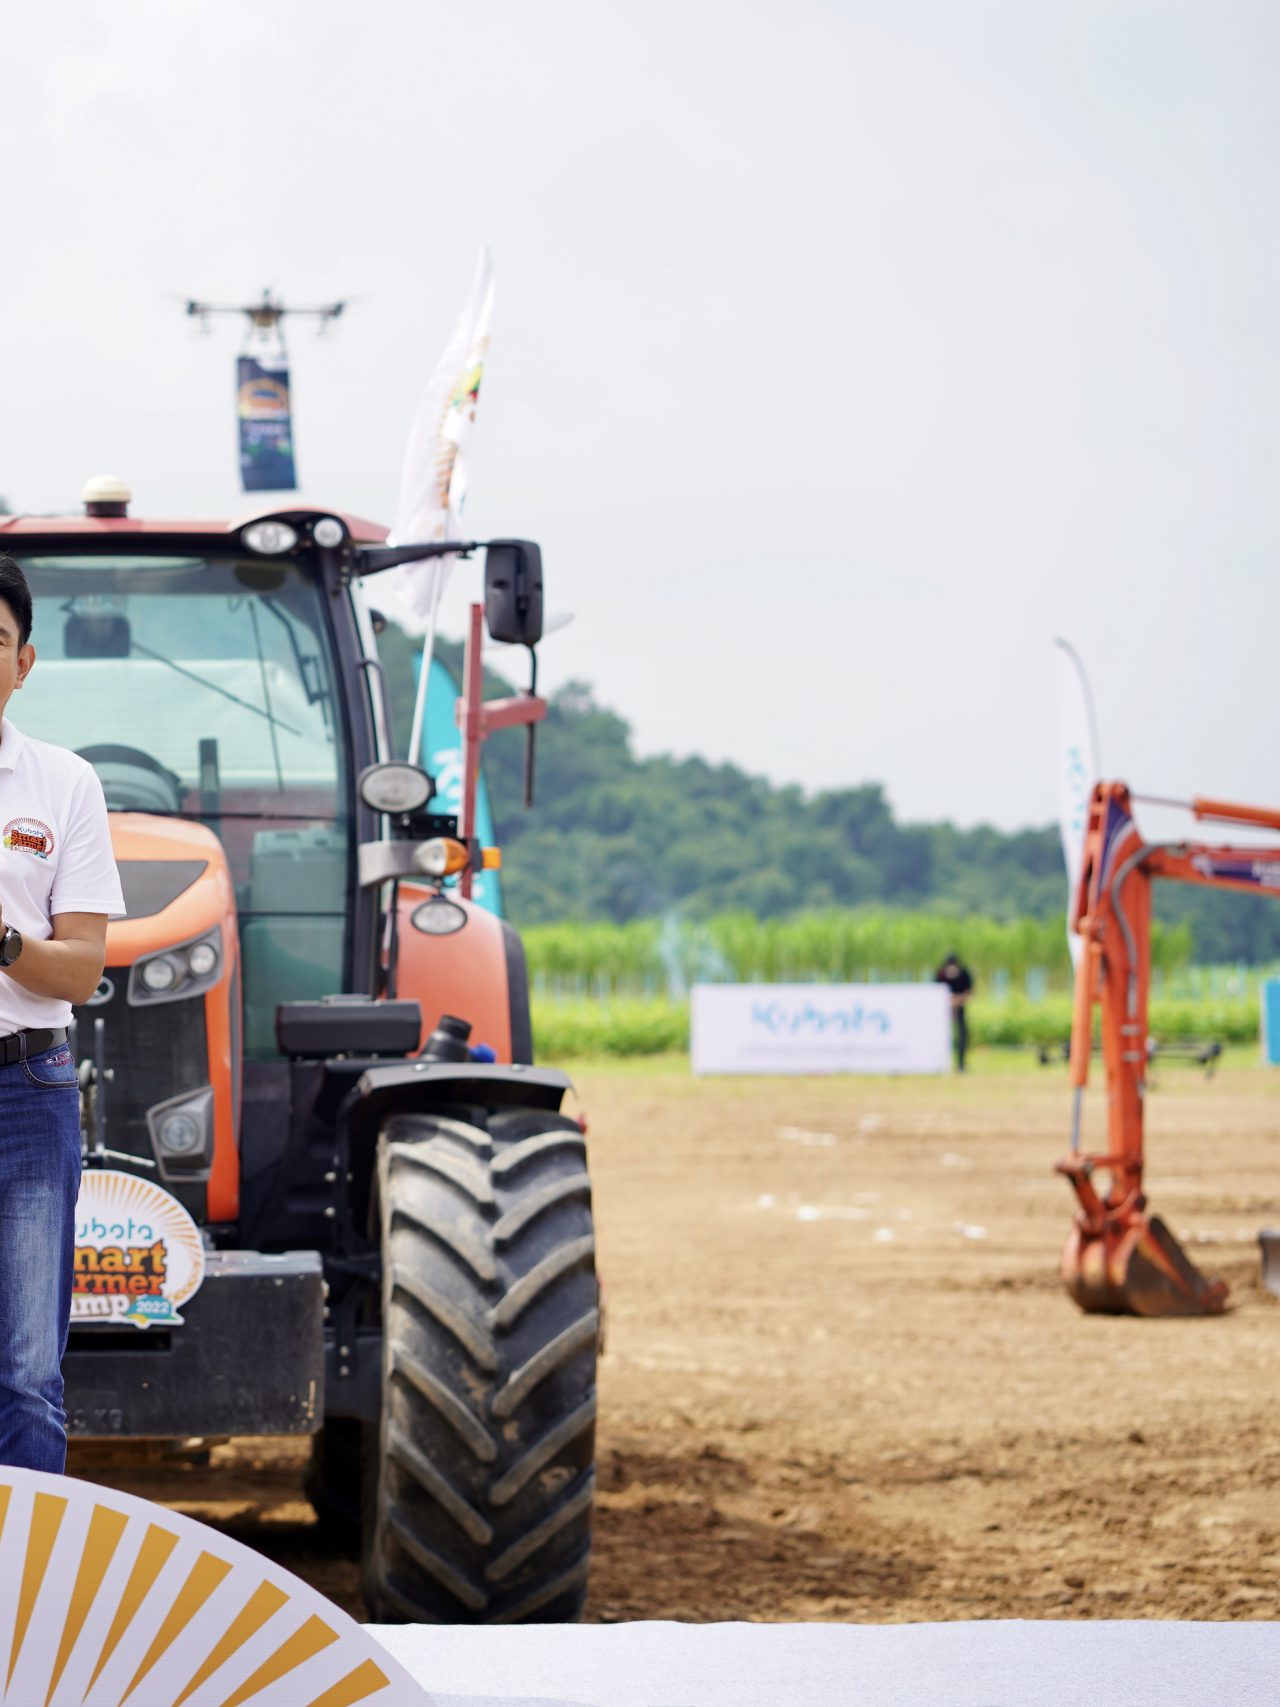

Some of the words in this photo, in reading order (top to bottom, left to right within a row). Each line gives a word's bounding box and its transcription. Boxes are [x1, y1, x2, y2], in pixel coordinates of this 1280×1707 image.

[76, 1217, 153, 1240] ubota
[74, 1240, 167, 1274] mart
[72, 1273, 165, 1295] rmer
[135, 1301, 170, 1315] 2022
